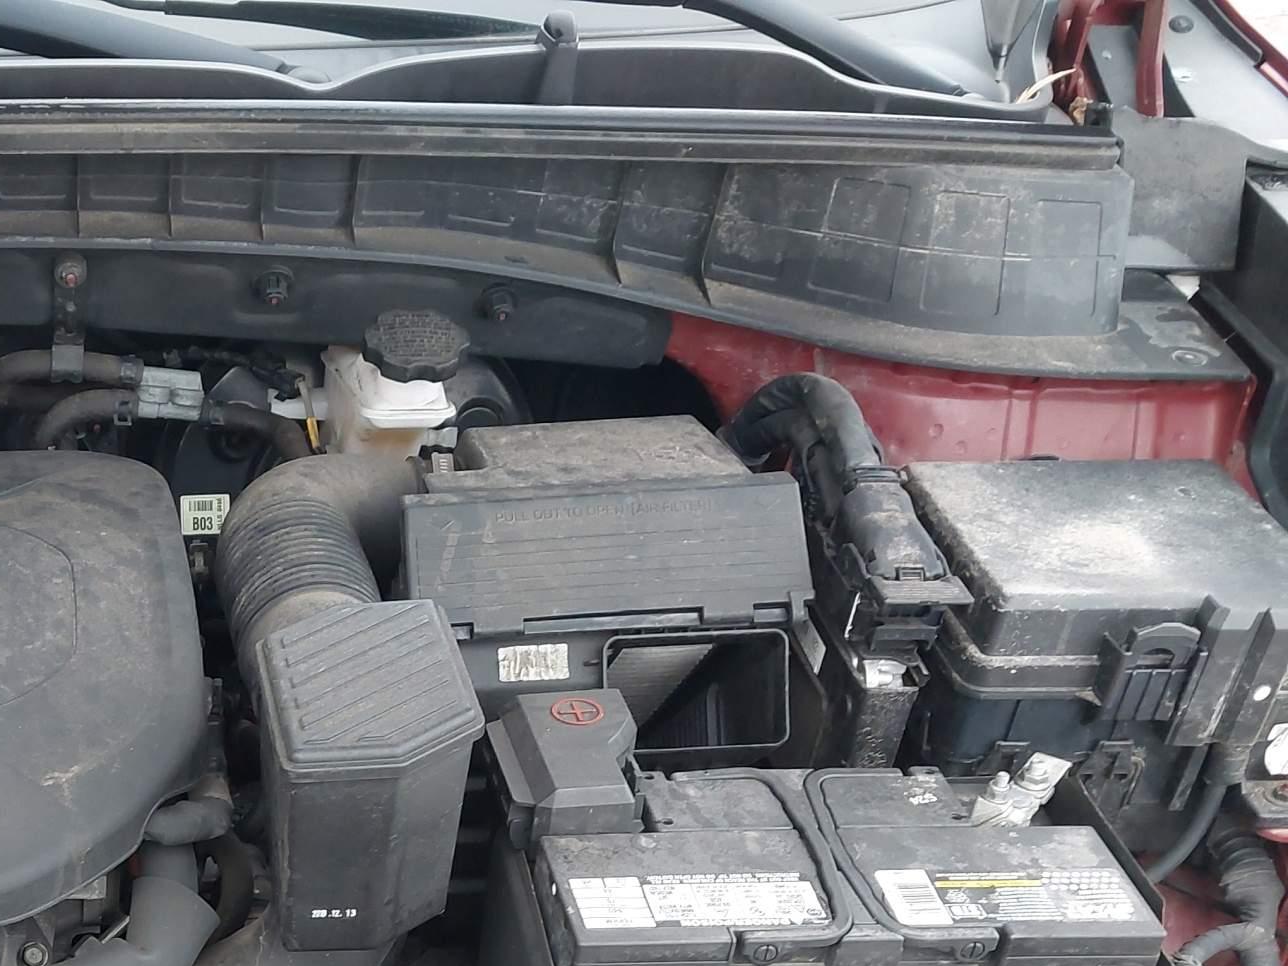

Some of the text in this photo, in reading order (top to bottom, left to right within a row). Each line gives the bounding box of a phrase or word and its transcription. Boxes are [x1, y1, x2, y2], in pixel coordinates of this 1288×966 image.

[495, 510, 530, 523] PULL
[565, 506, 583, 519] TO
[586, 504, 624, 518] OPEN
[192, 516, 214, 531] B03
